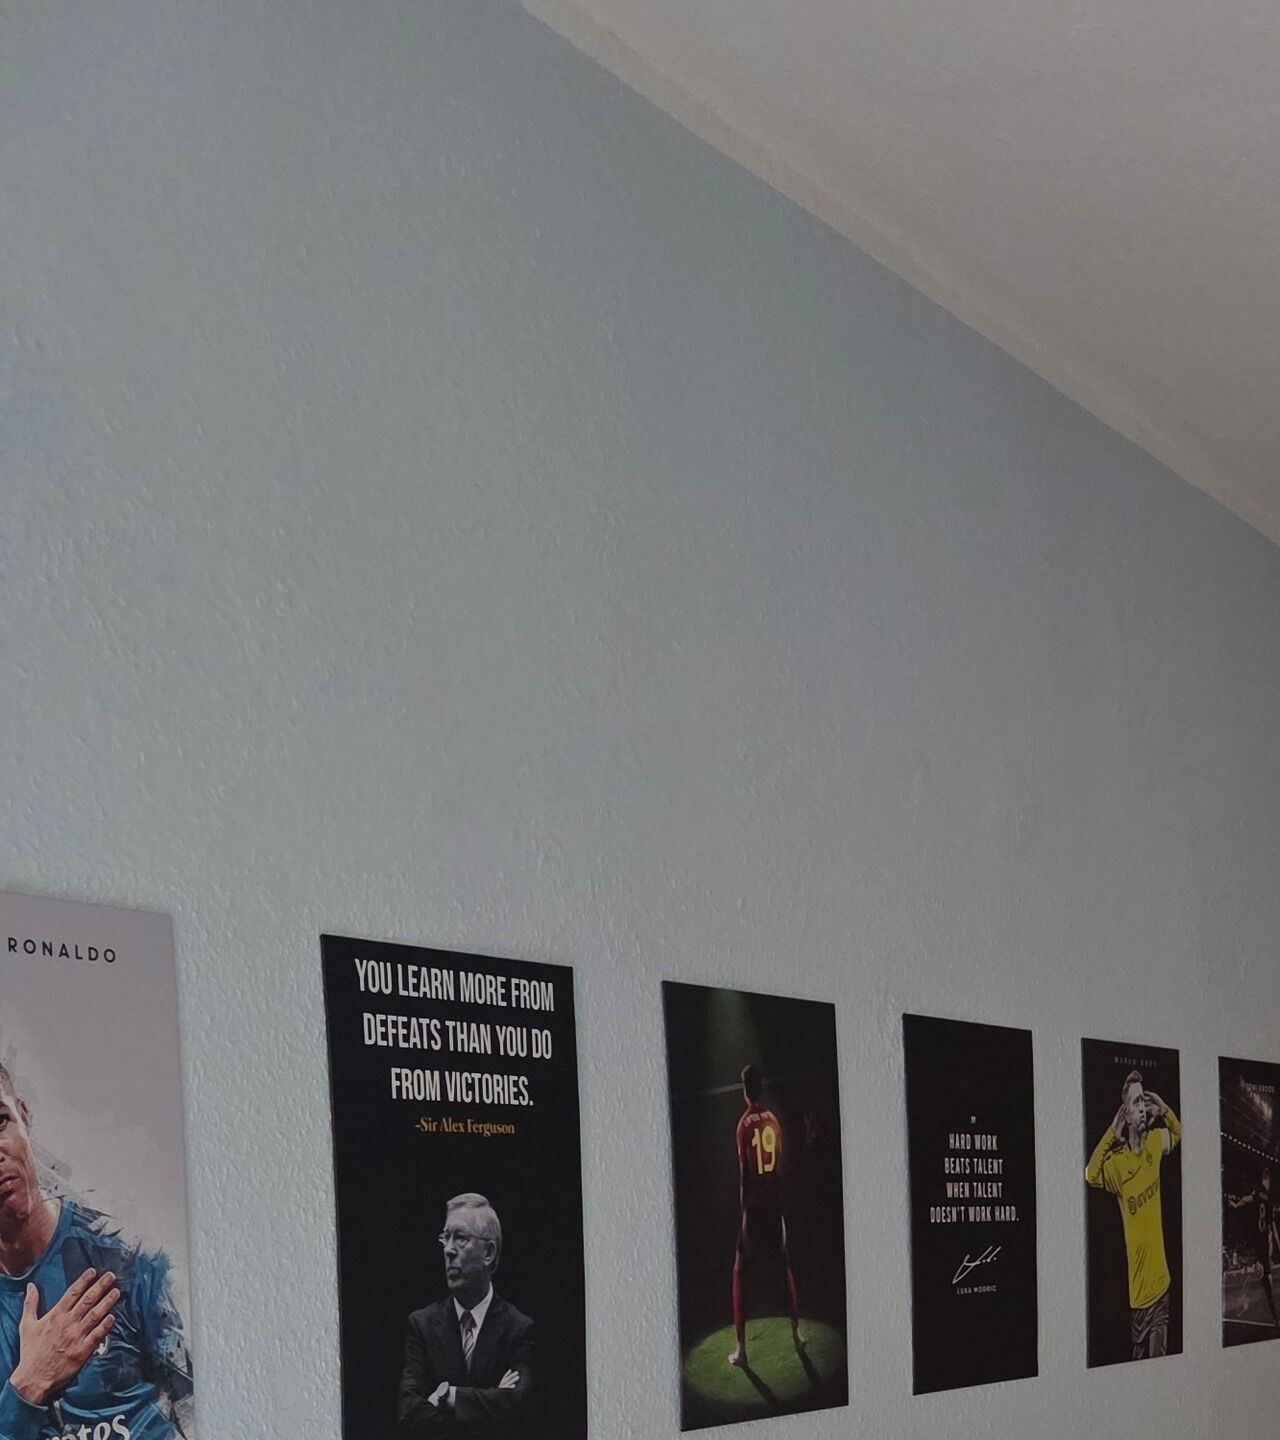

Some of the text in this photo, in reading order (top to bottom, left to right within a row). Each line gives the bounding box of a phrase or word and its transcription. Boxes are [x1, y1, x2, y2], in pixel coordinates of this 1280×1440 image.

[8, 937, 116, 963] RONALDO
[354, 958, 555, 1012] YOU LEARN MORE FROM
[363, 1012, 552, 1060] DEFEATS THAN YOU DO
[391, 1067, 534, 1106] FROM VICTORIES.
[439, 1117, 465, 1133] Alex
[467, 1119, 516, 1137] Ferguson
[751, 1126, 777, 1175] 19
[949, 1133, 998, 1151] HARD WORK
[944, 1157, 1003, 1174] BEATS TALENT
[946, 1182, 1003, 1198] WHEN TALENT
[930, 1206, 1020, 1223] DOESN'T WORK HARD.
